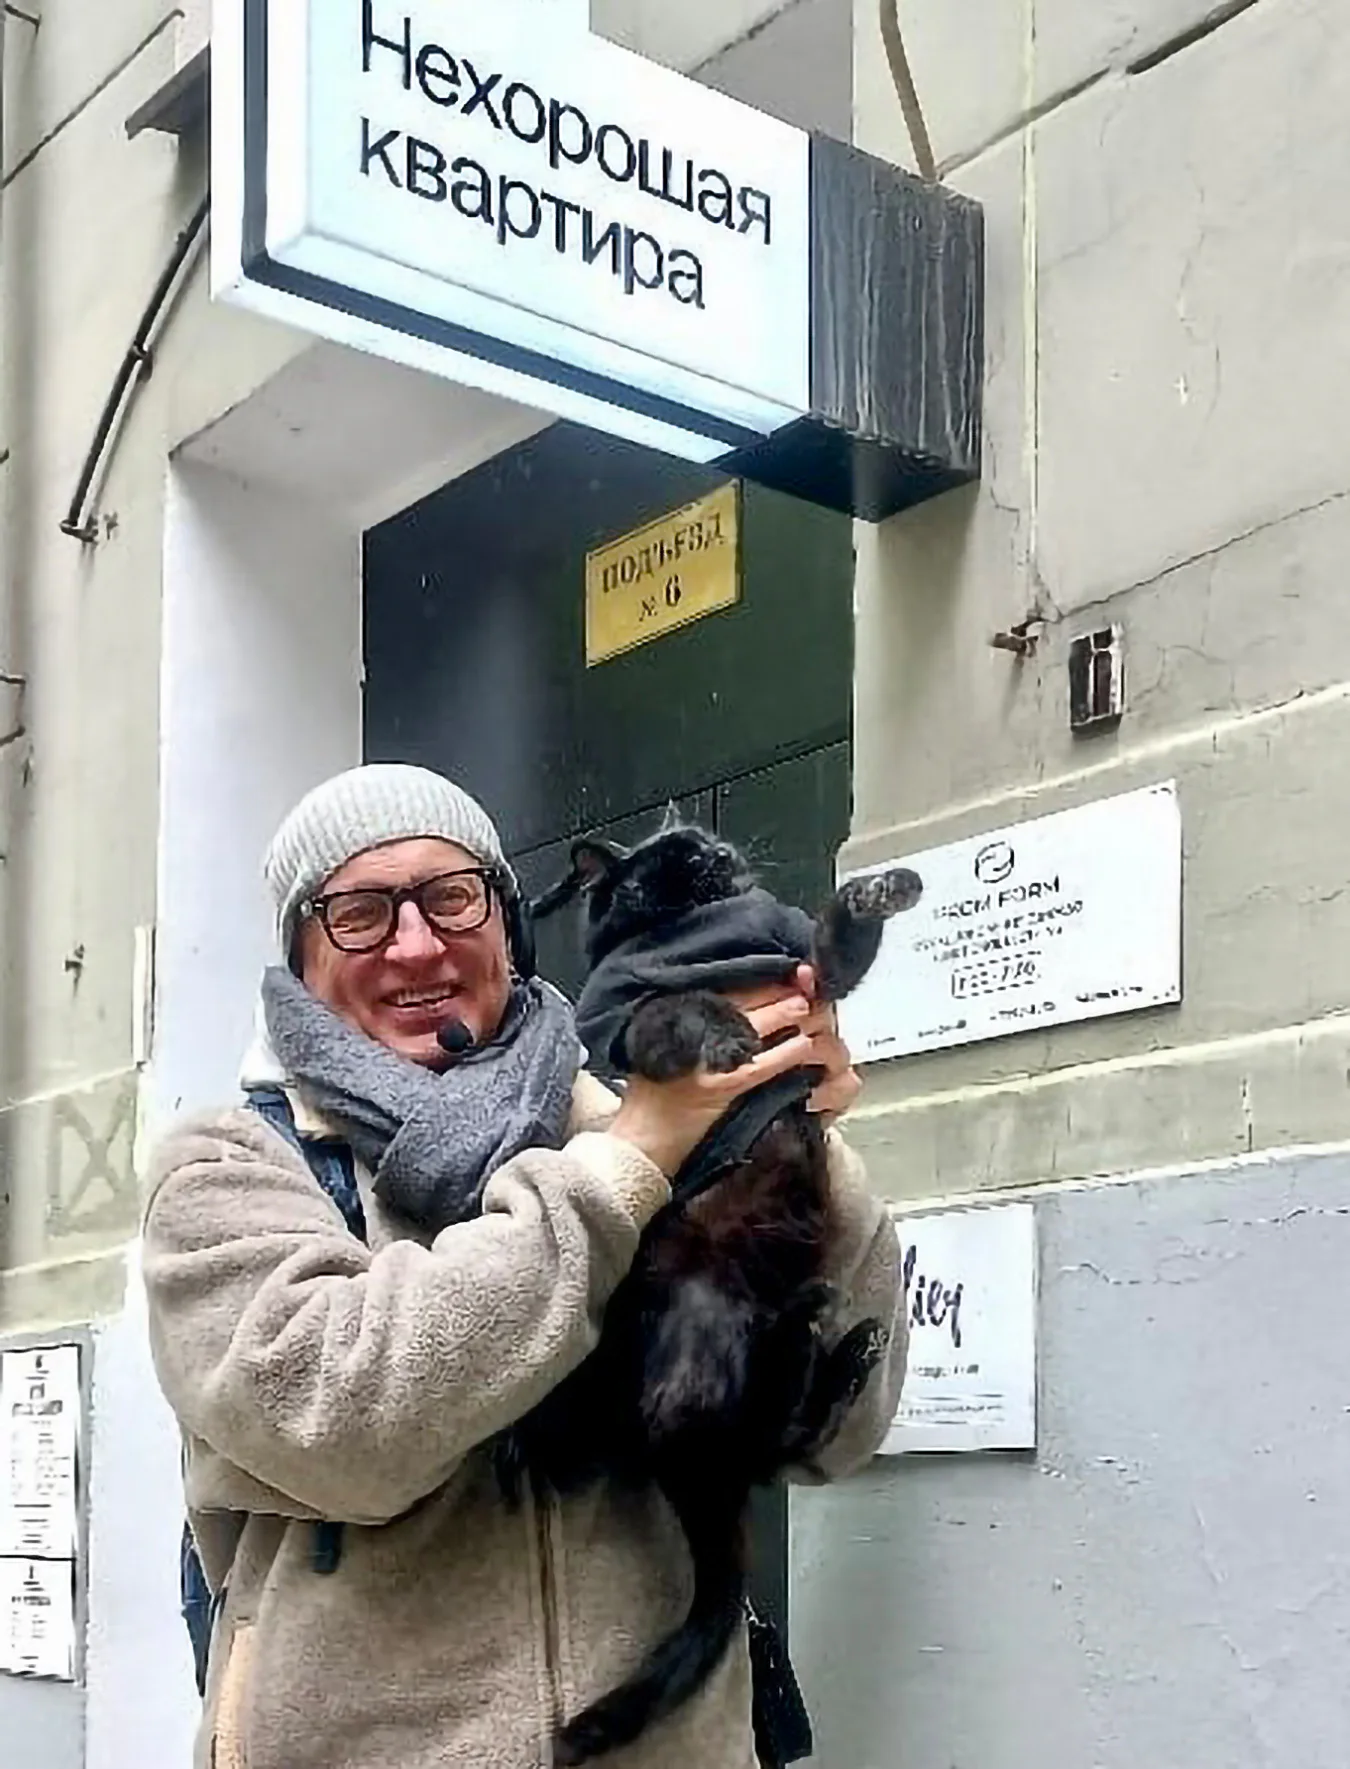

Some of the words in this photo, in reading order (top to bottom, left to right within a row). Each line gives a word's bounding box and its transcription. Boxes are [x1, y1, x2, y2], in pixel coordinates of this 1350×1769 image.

[360, 116, 705, 309] квартира
[362, 0, 771, 245] Нехорошая
[665, 574, 682, 608] 6
